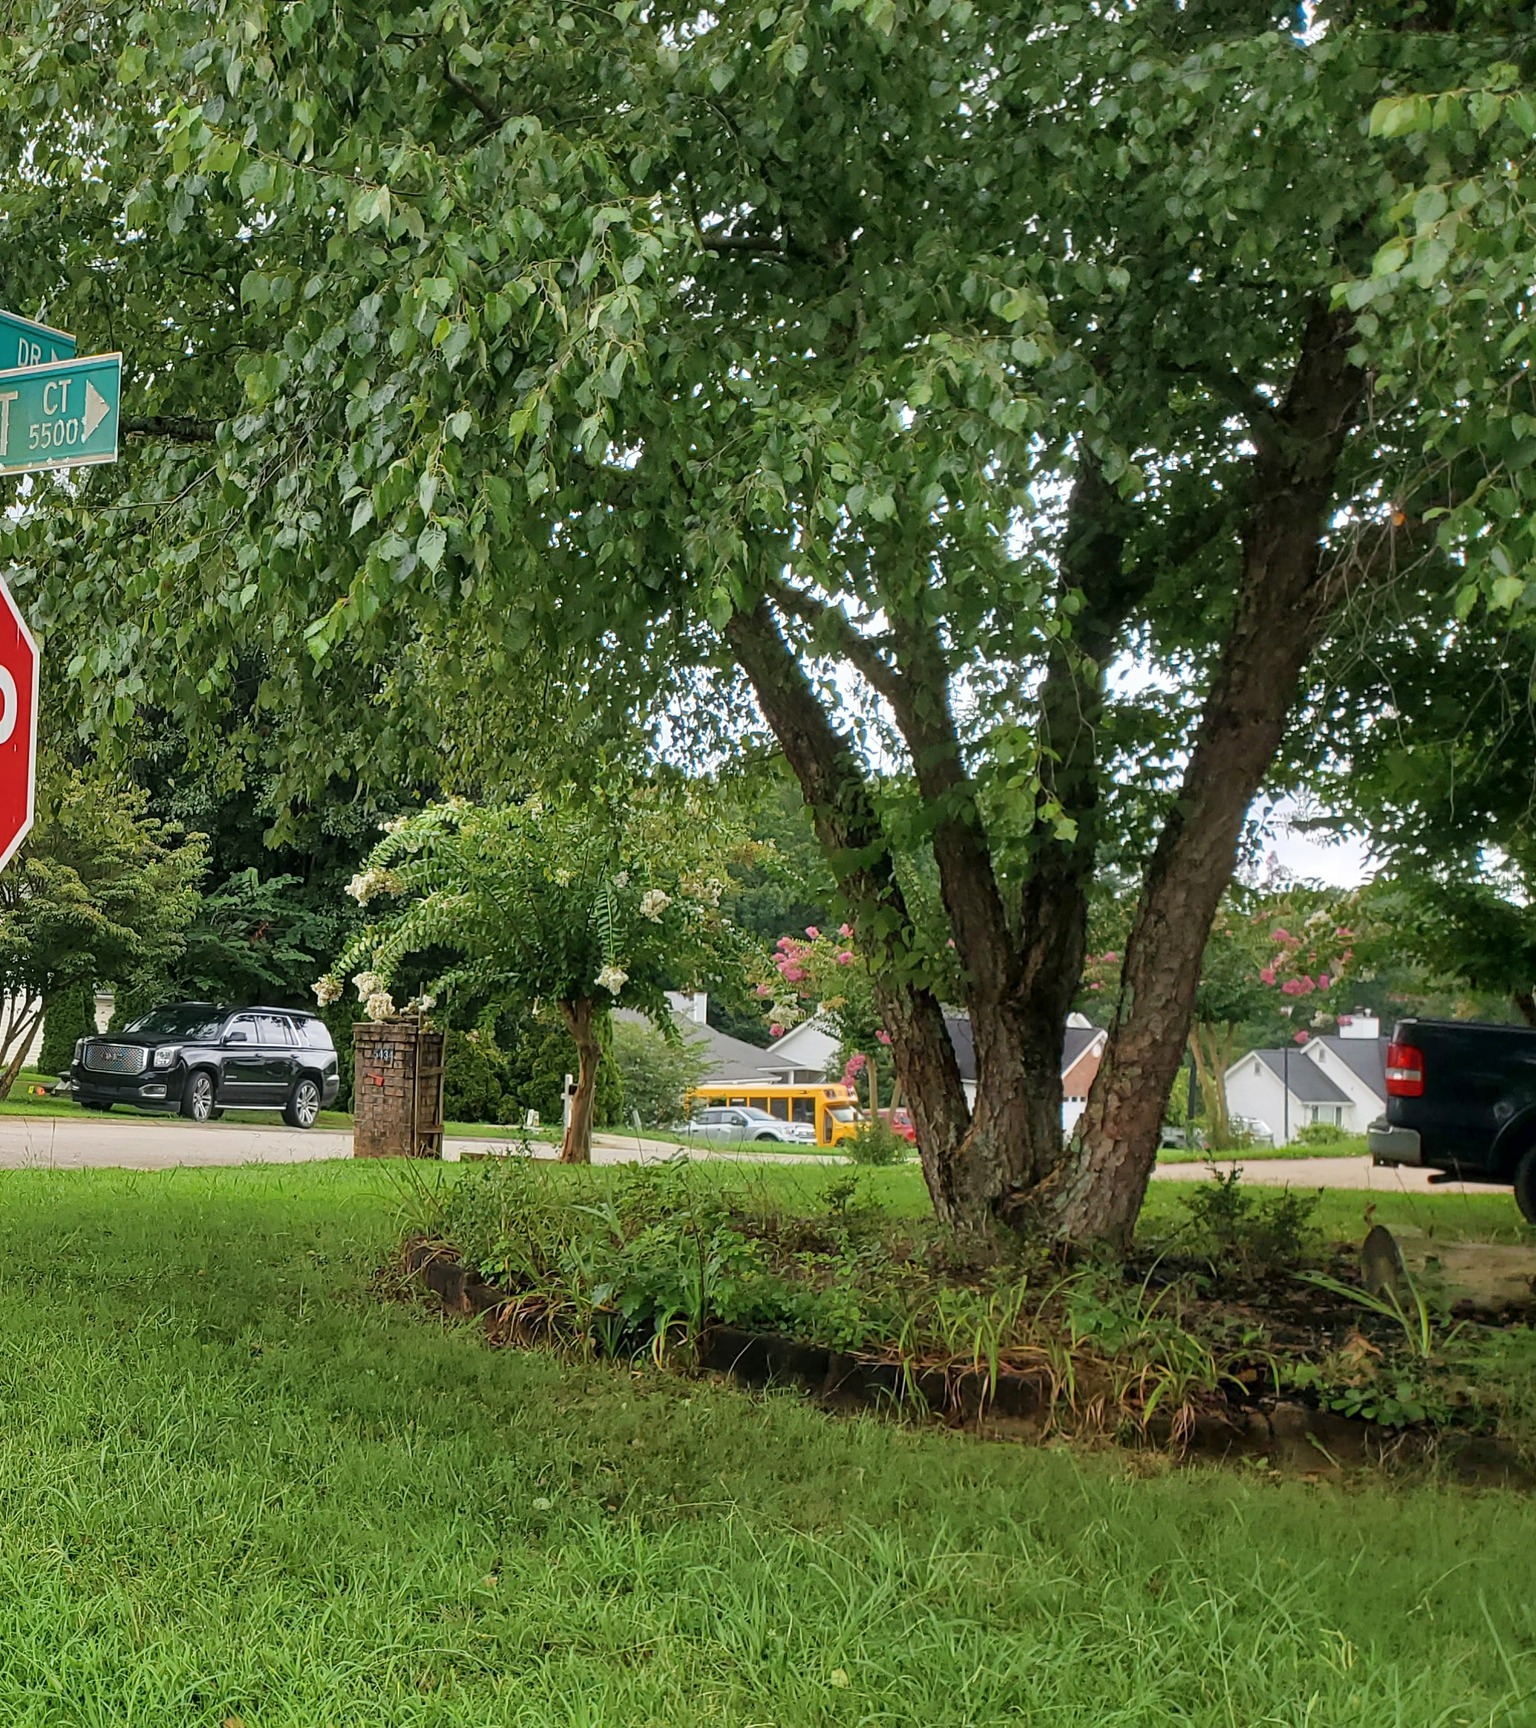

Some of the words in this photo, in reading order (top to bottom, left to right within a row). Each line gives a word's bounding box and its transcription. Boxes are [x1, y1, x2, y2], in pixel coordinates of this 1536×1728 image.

[17, 337, 42, 367] DR
[43, 379, 72, 415] CT
[28, 418, 79, 450] 5500
